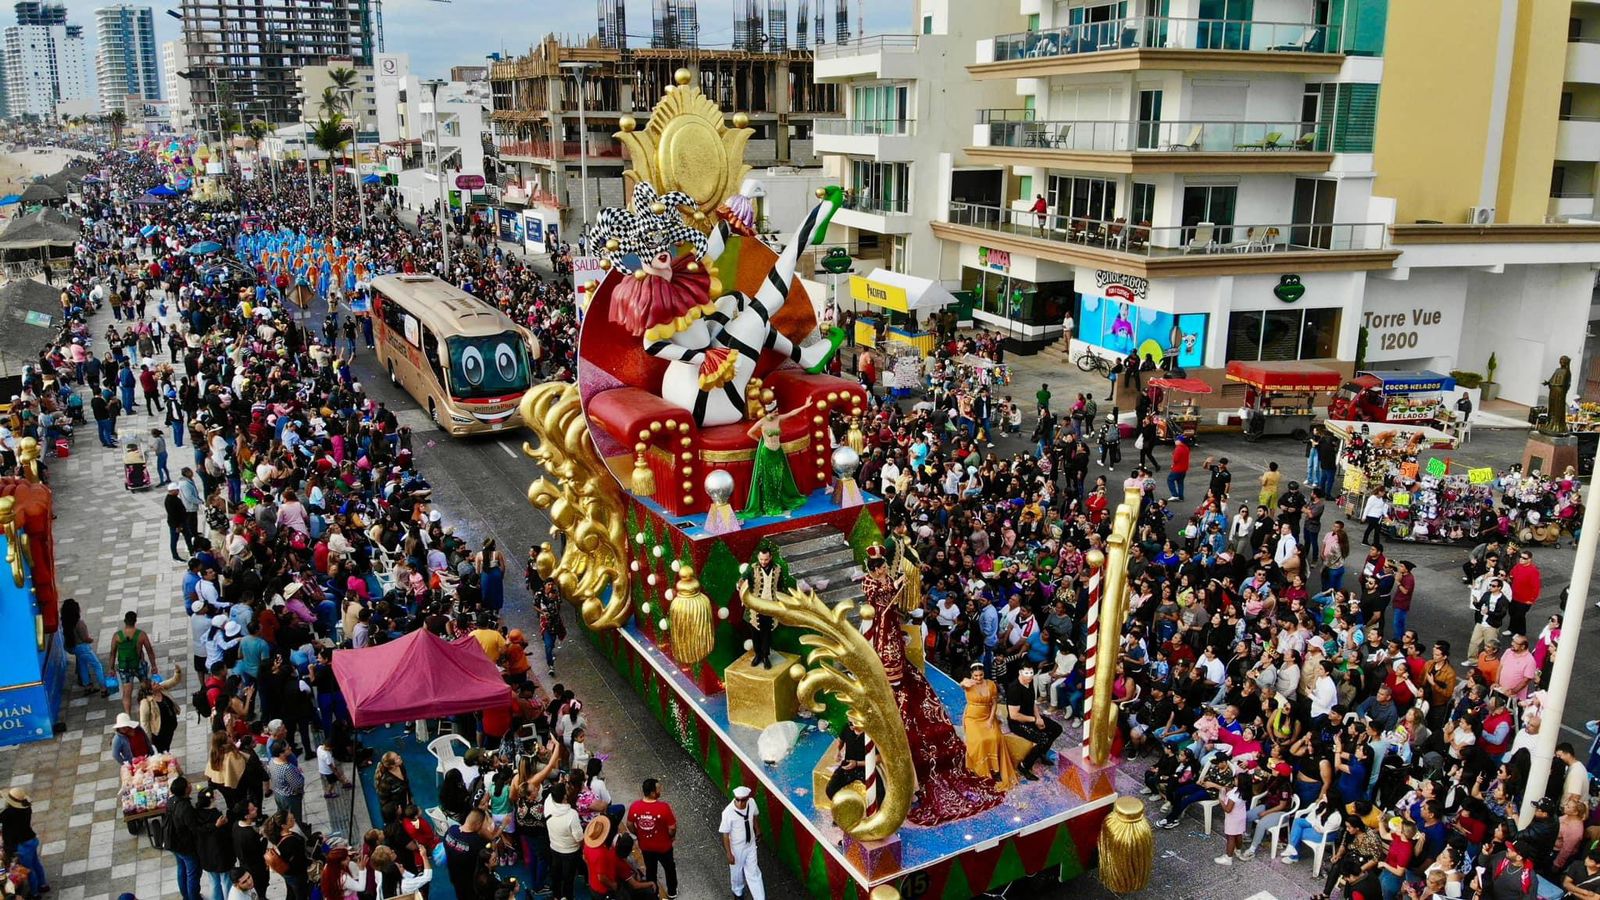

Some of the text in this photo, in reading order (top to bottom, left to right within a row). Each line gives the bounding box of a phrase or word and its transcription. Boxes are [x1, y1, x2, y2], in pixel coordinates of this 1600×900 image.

[574, 259, 599, 271] SALID
[1364, 309, 1442, 329] Torre Vue
[1380, 331, 1418, 350] 1200
